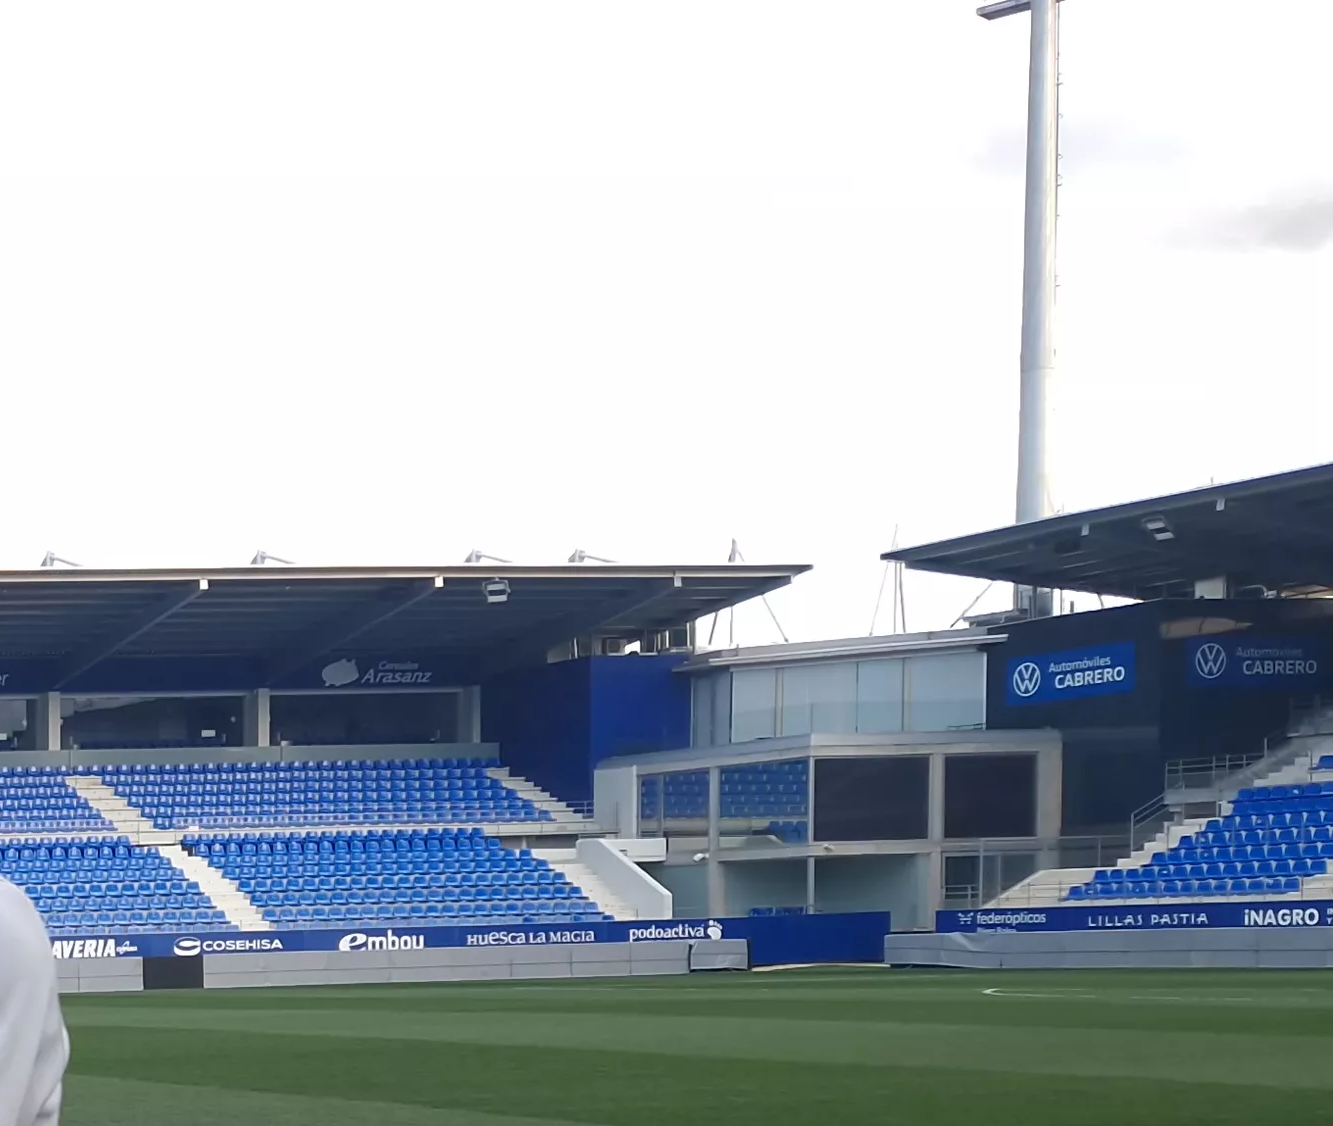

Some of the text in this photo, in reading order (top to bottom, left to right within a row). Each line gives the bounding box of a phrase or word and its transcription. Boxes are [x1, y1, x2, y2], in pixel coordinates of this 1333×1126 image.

[1049, 656, 1111, 673] Automóviles
[1243, 660, 1317, 675] CABRERO
[361, 668, 433, 683] Arasanz
[1055, 666, 1125, 689] CABRERO
[976, 911, 1047, 926] federópticos
[1088, 913, 1209, 927] LILLAS PASTIA
[202, 938, 284, 952] COSEHISA
[338, 929, 425, 952] embou
